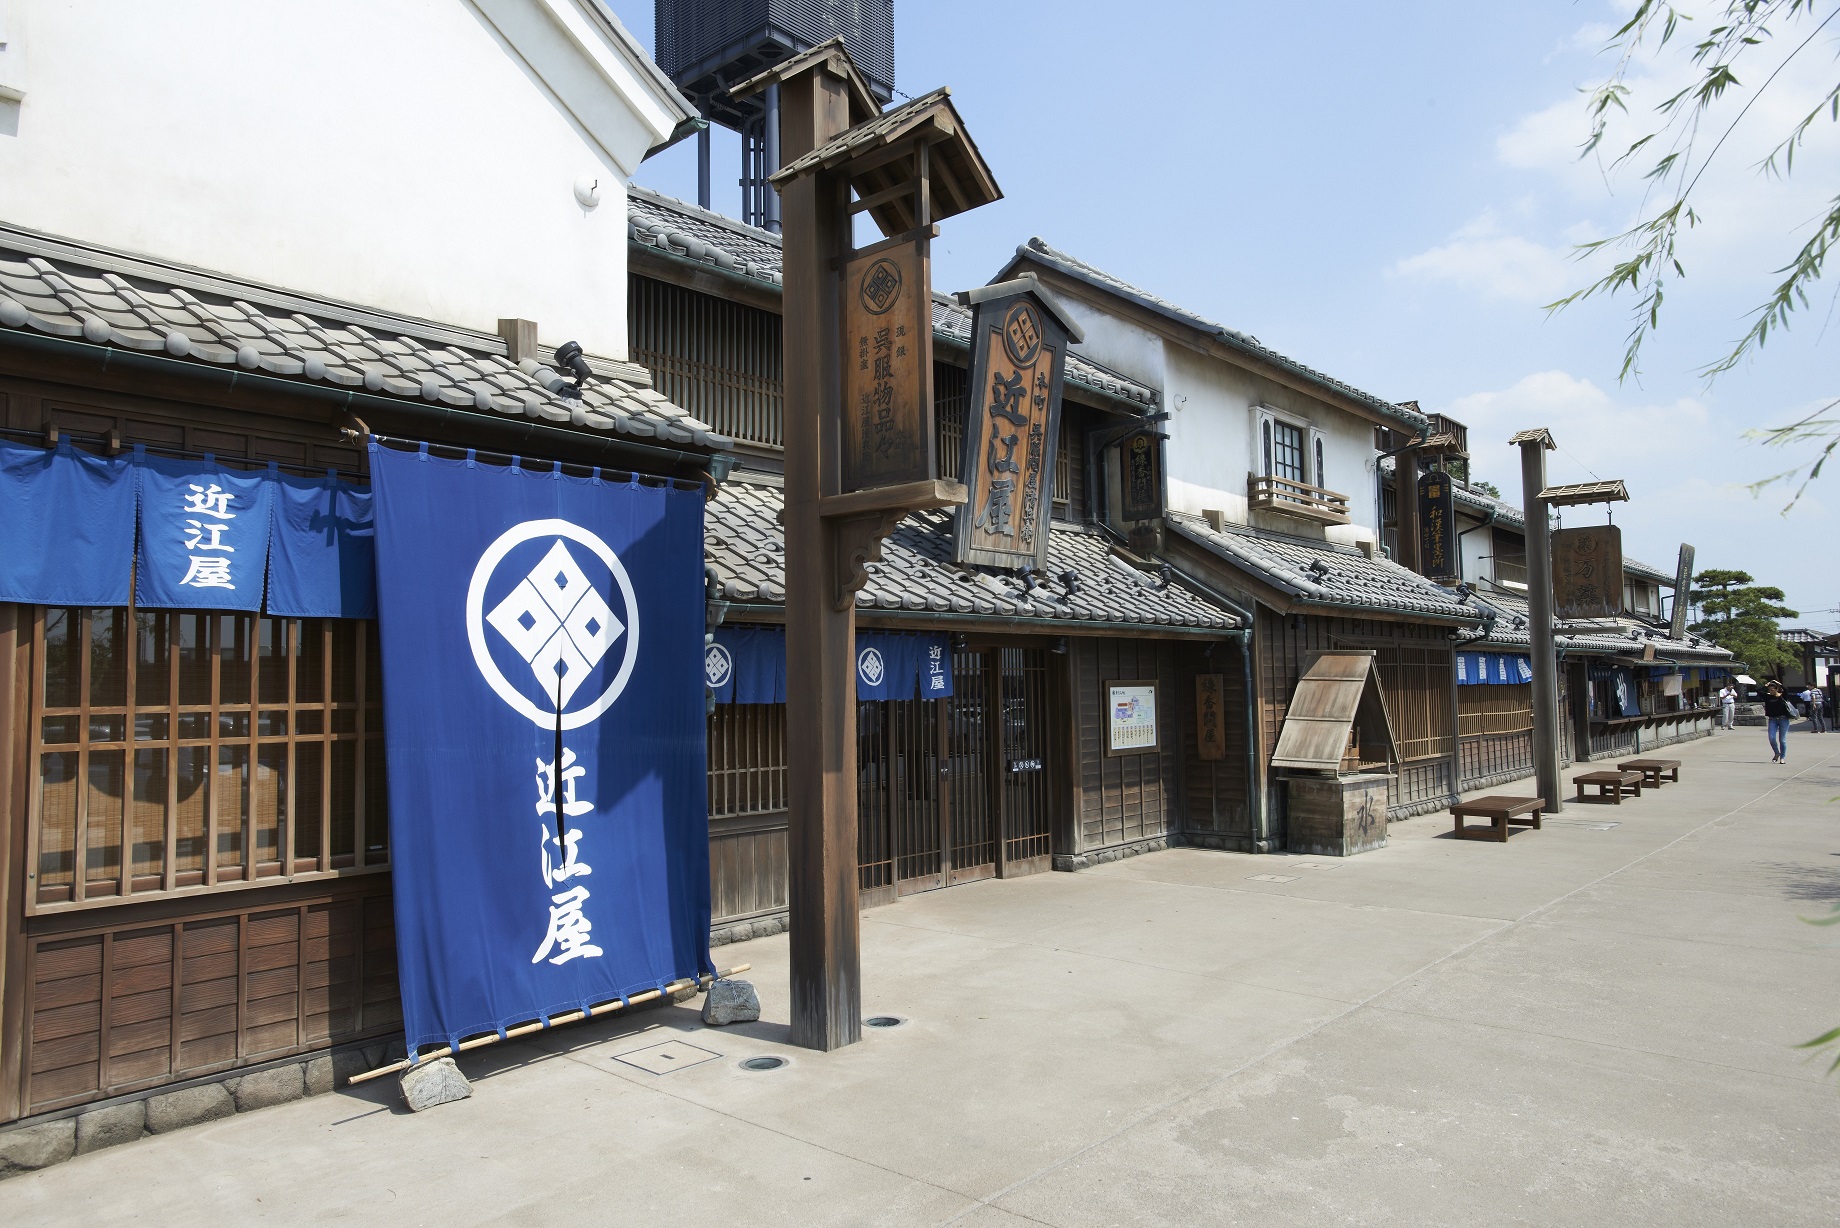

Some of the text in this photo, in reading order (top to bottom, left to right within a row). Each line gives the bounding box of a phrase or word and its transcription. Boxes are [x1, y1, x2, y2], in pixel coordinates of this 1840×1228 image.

[873, 327, 895, 459] 呉服物品々
[976, 371, 1028, 536] 近江屋
[179, 483, 236, 590] 近江屋
[929, 645, 945, 691] 近江屋
[531, 748, 603, 965] 近江屋
[1356, 789, 1376, 837] 水
